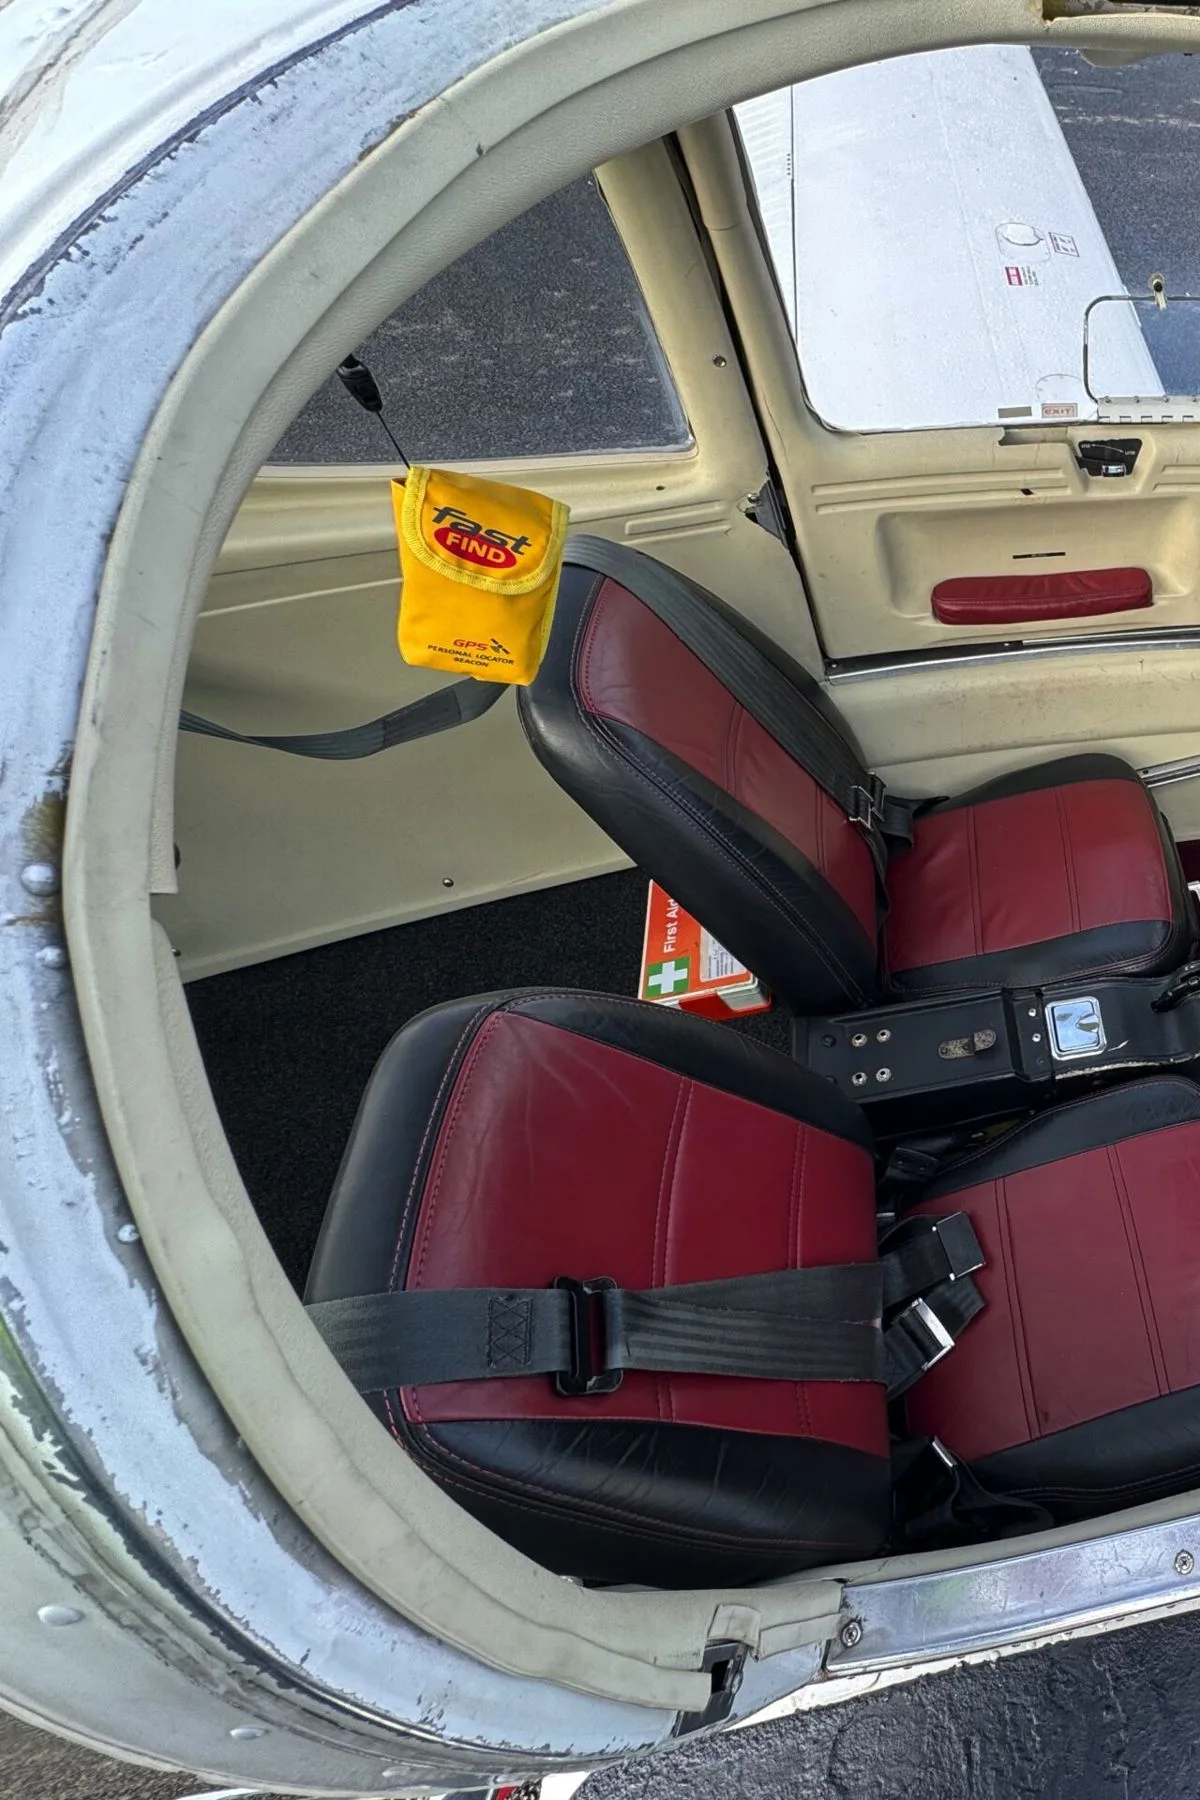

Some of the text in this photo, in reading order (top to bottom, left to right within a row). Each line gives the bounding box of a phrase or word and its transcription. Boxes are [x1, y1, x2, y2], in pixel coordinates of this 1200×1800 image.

[1044, 408, 1071, 416] EXIT
[446, 531, 506, 563] FIND
[453, 638, 489, 651] GPS
[427, 644, 515, 665] PERSONAL LOCATOR
[453, 657, 489, 667] BEACON
[663, 920, 678, 953] First
